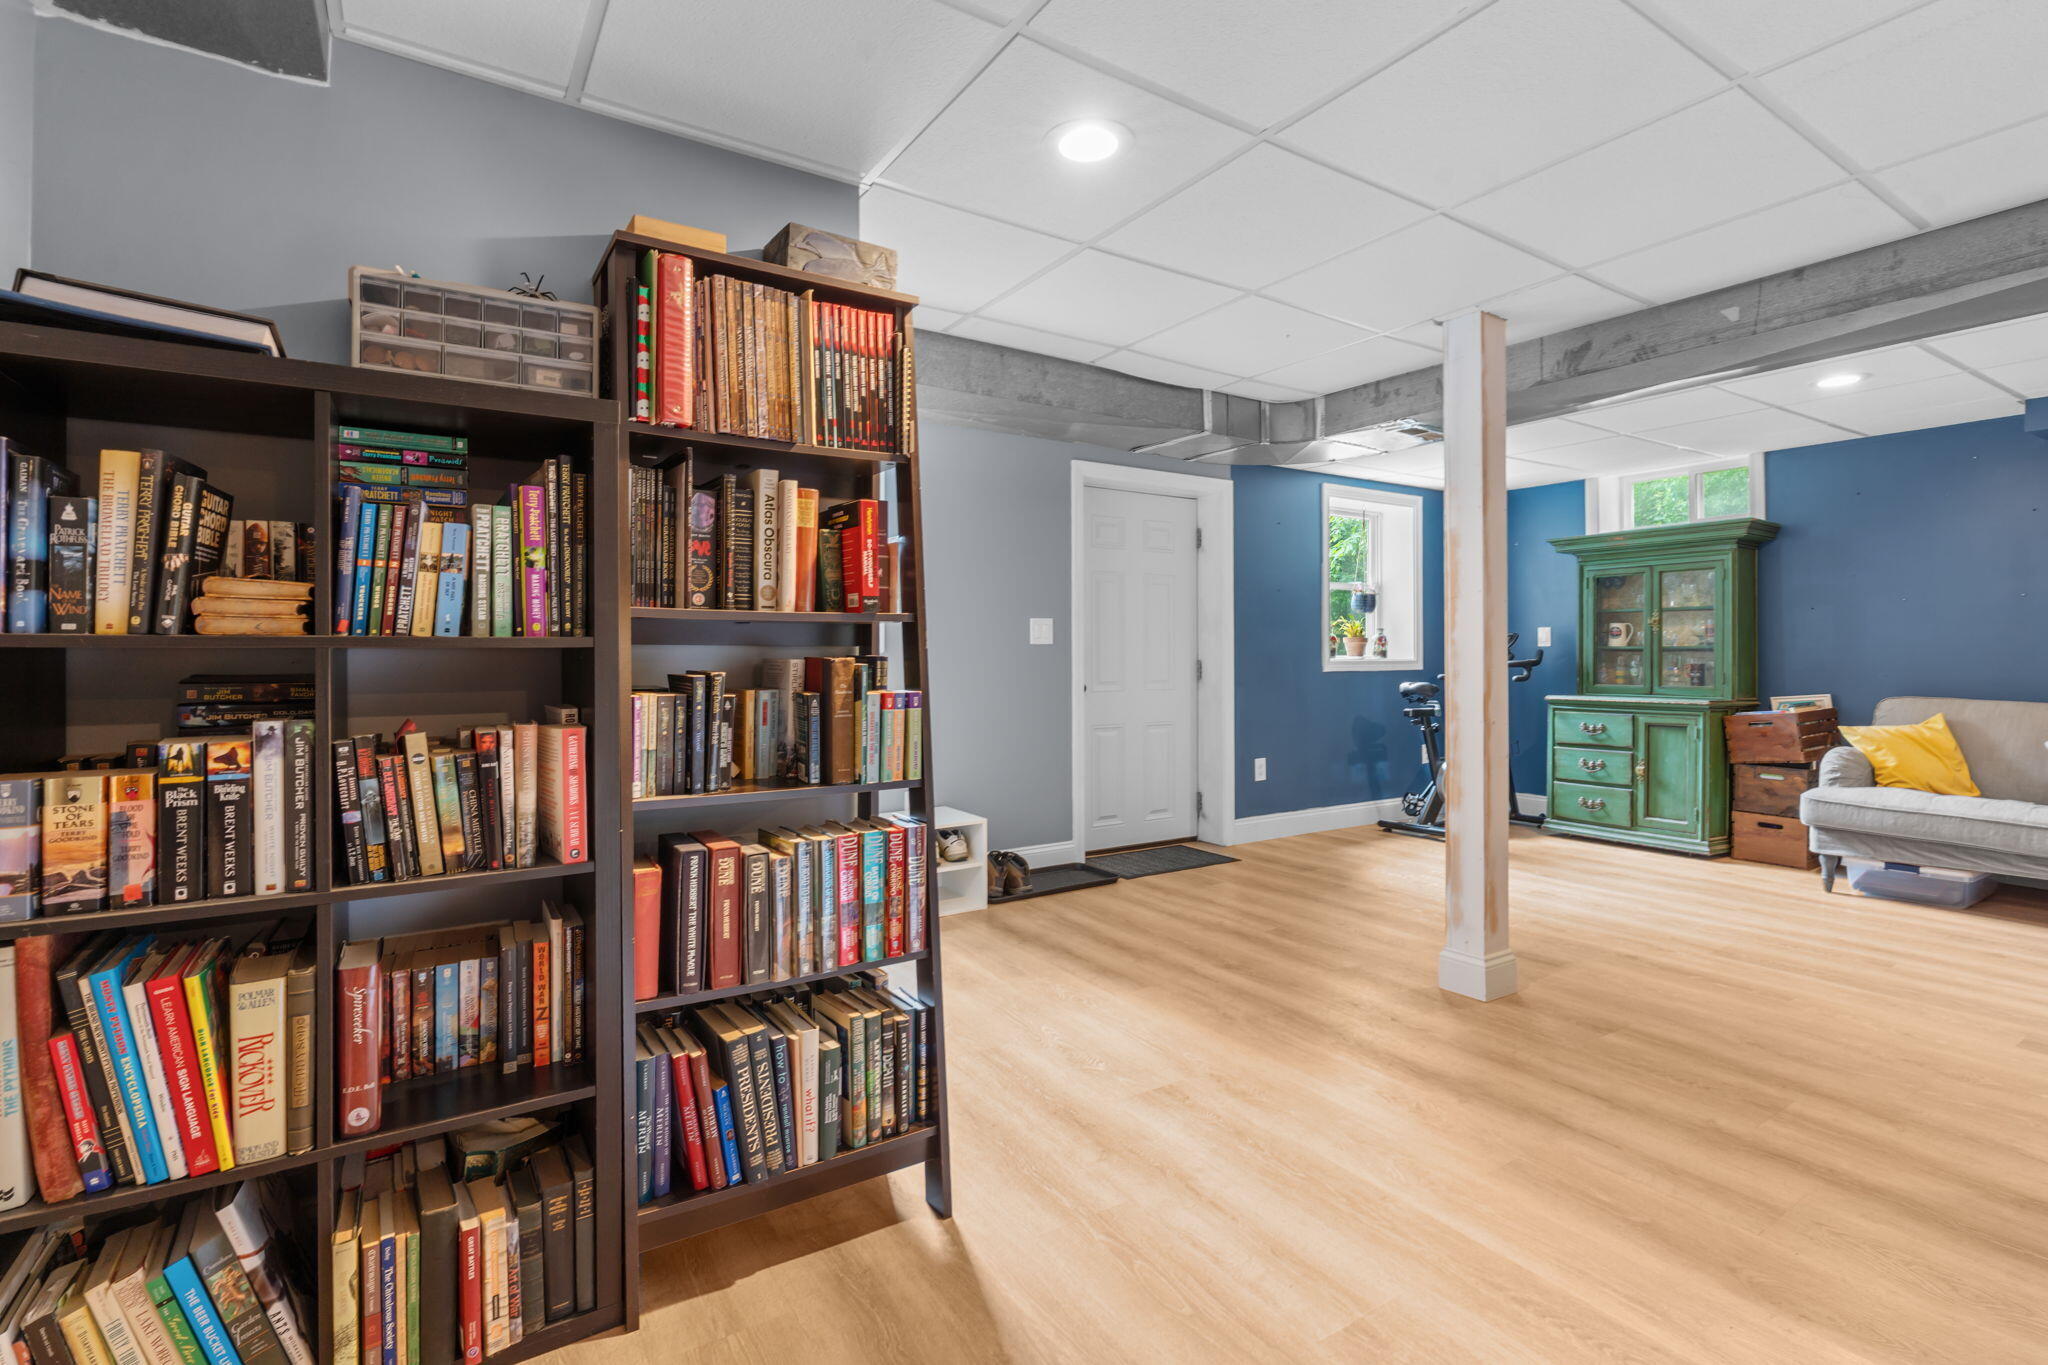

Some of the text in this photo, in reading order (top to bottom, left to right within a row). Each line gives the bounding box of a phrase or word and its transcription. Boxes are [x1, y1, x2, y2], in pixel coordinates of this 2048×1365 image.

[19, 462, 28, 493] GAIMAN
[560, 463, 572, 525] TERRY PRATCHETT
[134, 474, 154, 561] TERRY PRATCHETT
[166, 484, 185, 548] CHORD BIBLE
[179, 501, 193, 537] GUITAR
[202, 488, 230, 514] GUITAR
[525, 489, 542, 540] Terry Pratchett
[576, 476, 585, 540] TERRY PRATCHETT
[50, 533, 88, 545] ROTHFUSS
[53, 523, 86, 536] PATRICK
[97, 471, 115, 602] THE BROMELIAD TRILOGY
[113, 490, 130, 587] TERRY PRATCHETT
[361, 508, 373, 558] TERRY PRATCHETT
[376, 509, 389, 559] TERRY PRATCHETT
[390, 528, 402, 560] PRATCHETT
[475, 513, 490, 571] PRATCHETT
[495, 516, 511, 577] PRATCHETT
[549, 528, 557, 541] LAST
[763, 493, 775, 581] Atlas Obscura
[562, 547, 572, 585] DISCWORLD
[16, 578, 28, 605] Book
[50, 588, 83, 601] NAME
[51, 600, 88, 616] WIND
[356, 584, 366, 621] TRUCKERS
[397, 584, 412, 629] PRATCHETT
[476, 599, 487, 620] STEAM
[531, 573, 542, 619] MAKING MONEY
[294, 737, 305, 752] JIM
[568, 734, 580, 770] GATHERING
[165, 790, 198, 801] Black
[213, 784, 247, 796] Blinding
[218, 791, 242, 802] Knife
[263, 773, 275, 821] BUTCHER
[294, 754, 305, 810] BUTCHER
[337, 773, 350, 810] LOVECRAFT
[568, 774, 580, 806] SHADOWS
[52, 804, 95, 814] STONE
[65, 812, 83, 821] OF
[119, 803, 144, 813] BLOOD
[165, 798, 199, 808] Prism
[468, 789, 480, 816] CHINA
[48, 834, 98, 844] GOODKIND
[53, 819, 95, 829] TEARS
[60, 830, 87, 838] TERRY
[222, 805, 236, 878] BRENT WEEKS
[175, 809, 188, 883] BRENT WEEKS
[297, 812, 306, 877] PROVEN GUILTY
[840, 836, 858, 869] DUNE
[864, 834, 884, 866] DUNE
[888, 833, 903, 863] DUNE
[688, 855, 699, 911] FRANK HERBERT
[718, 857, 730, 887] DUNE
[750, 861, 763, 895] DUNE
[889, 863, 897, 896] CORRINO
[908, 855, 925, 886] DUNE
[685, 910, 697, 977] THE WHITE PLAGUE
[537, 945, 546, 983] WORLD
[237, 988, 275, 1001] POLMAR
[248, 998, 277, 1009] ALLEN
[343, 985, 375, 1045] Spineseeker
[536, 1006, 549, 1022] Z
[99, 979, 114, 1013] MONTY
[108, 1015, 128, 1056] PYTHON
[120, 1055, 147, 1129] ENCYCLOPEDIA
[159, 996, 202, 1140] LEARN AMERICAN SIGN LANGUAGE
[197, 1028, 214, 1088] SIGN LANGUAGE
[775, 1043, 787, 1084] how to
[882, 1054, 894, 1088] DEATH
[2, 1039, 19, 1117] THE PYTHONS
[238, 1032, 275, 1119] RICKOVER
[707, 1104, 718, 1138] MERLIN
[737, 1065, 760, 1153] PRESIDENTS
[757, 1061, 779, 1148] PRESIDENTS
[804, 1088, 817, 1133] what if?
[638, 1110, 647, 1154] MERLIN
[655, 1107, 664, 1146] MERLIN
[682, 1105, 695, 1142] MERLIN
[782, 1103, 792, 1154] randall munroe
[466, 1235, 475, 1281] GREAT BATTLES
[509, 1284, 518, 1293] of
[509, 1295, 520, 1318] War
[135, 1308, 158, 1337] LAKE
[183, 1287, 227, 1358] THE BEER BUCKET
[269, 1310, 290, 1336] ANTS
[383, 1266, 395, 1350] The Chivalrous Society
